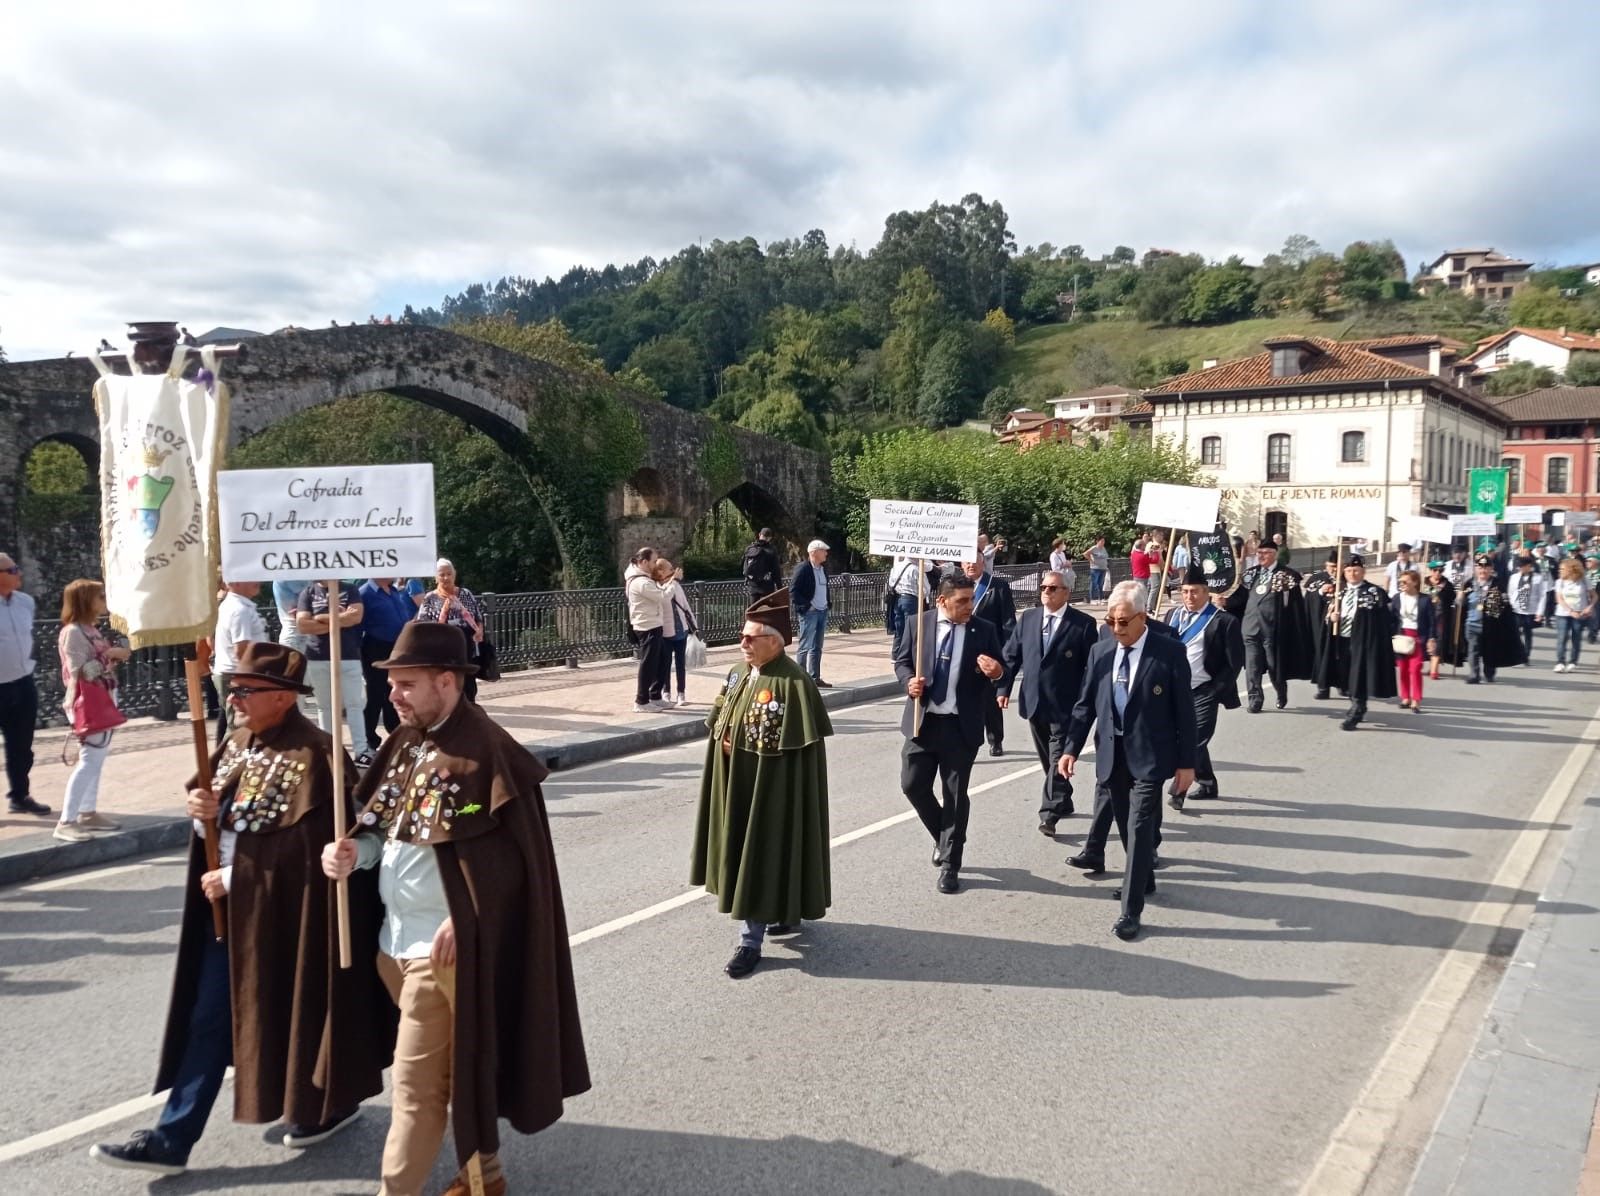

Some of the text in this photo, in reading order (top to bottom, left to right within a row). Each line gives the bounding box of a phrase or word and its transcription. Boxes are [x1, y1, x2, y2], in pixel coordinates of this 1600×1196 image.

[288, 478, 363, 502] Cofradia
[1263, 490, 1277, 500] EL
[1280, 489, 1327, 500] PUENTE
[1330, 488, 1382, 499] ROMANO
[884, 504, 963, 518] Sociedad Cultural
[240, 507, 414, 532] Del Arroz con Leche
[890, 521, 895, 529] y
[896, 530, 904, 540] la
[884, 544, 962, 557] POLA DE LAVIANA
[261, 549, 399, 571] CABRANES
